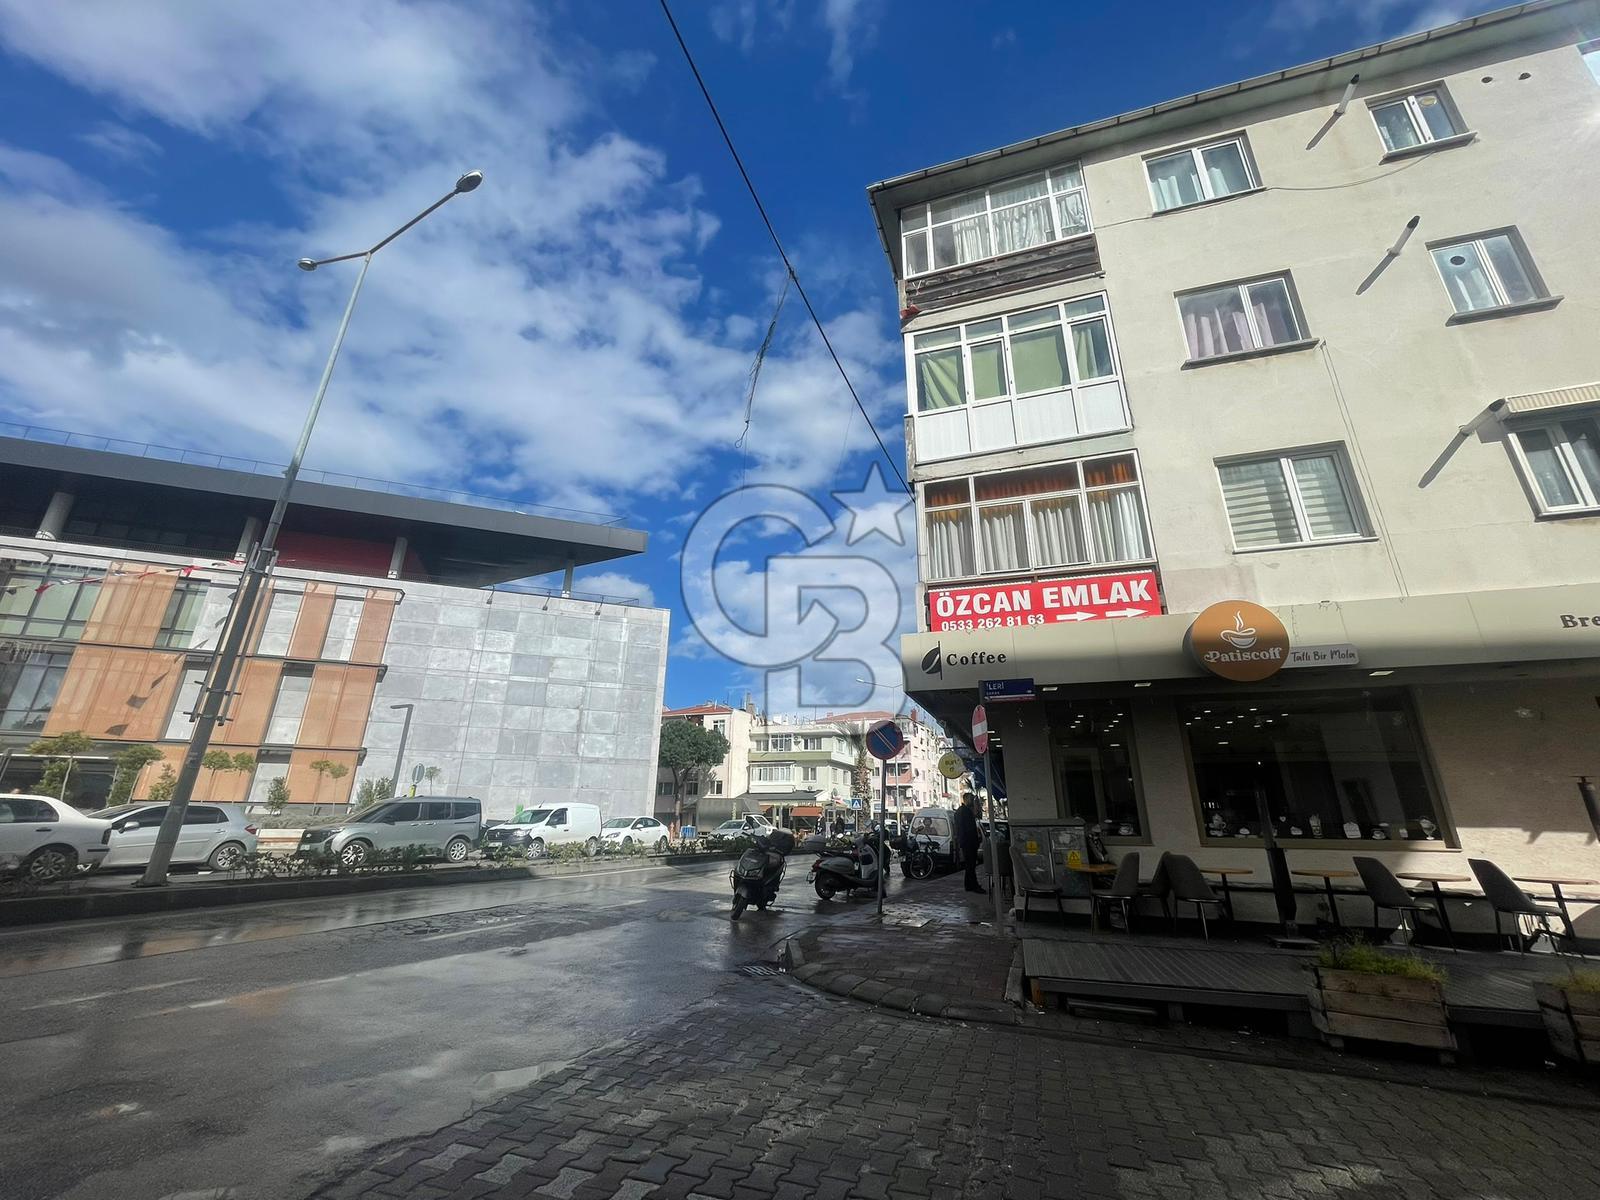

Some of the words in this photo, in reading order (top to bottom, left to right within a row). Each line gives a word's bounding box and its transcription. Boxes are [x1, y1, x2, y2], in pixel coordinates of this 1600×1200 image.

[937, 590, 1032, 617] ÖZCAN
[1043, 579, 1152, 608] EMLAK
[942, 620, 973, 632] 0533
[977, 617, 1001, 630] 262
[1006, 615, 1022, 627] 81
[1027, 613, 1045, 625] 63
[946, 652, 1007, 666] Coffee
[1204, 647, 1281, 662] Patiscoff
[1313, 651, 1327, 661] Bir
[1330, 649, 1355, 660] Mola
